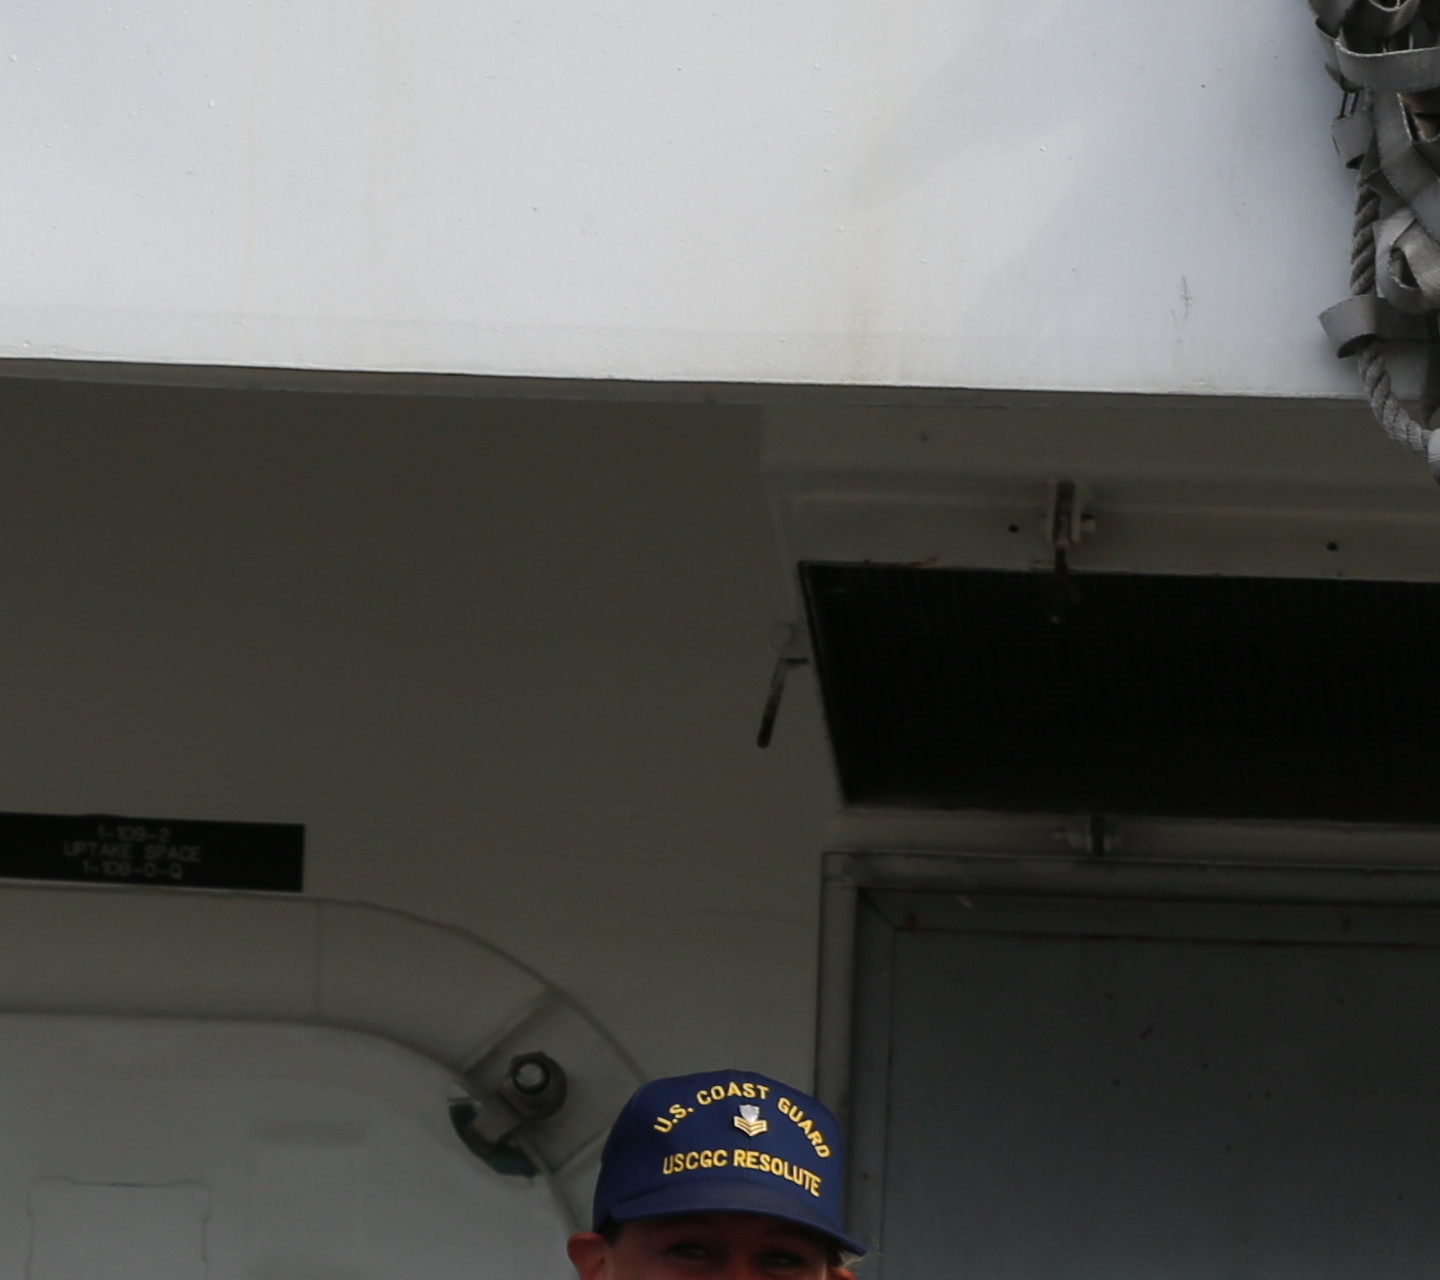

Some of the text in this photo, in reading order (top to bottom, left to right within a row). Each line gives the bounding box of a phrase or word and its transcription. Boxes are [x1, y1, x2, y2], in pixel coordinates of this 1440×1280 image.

[64, 841, 201, 862] UPTAKE SPACE
[654, 1081, 831, 1159] U.S. COAST GUARD
[663, 1149, 822, 1197] USCGC RESOLUTE
